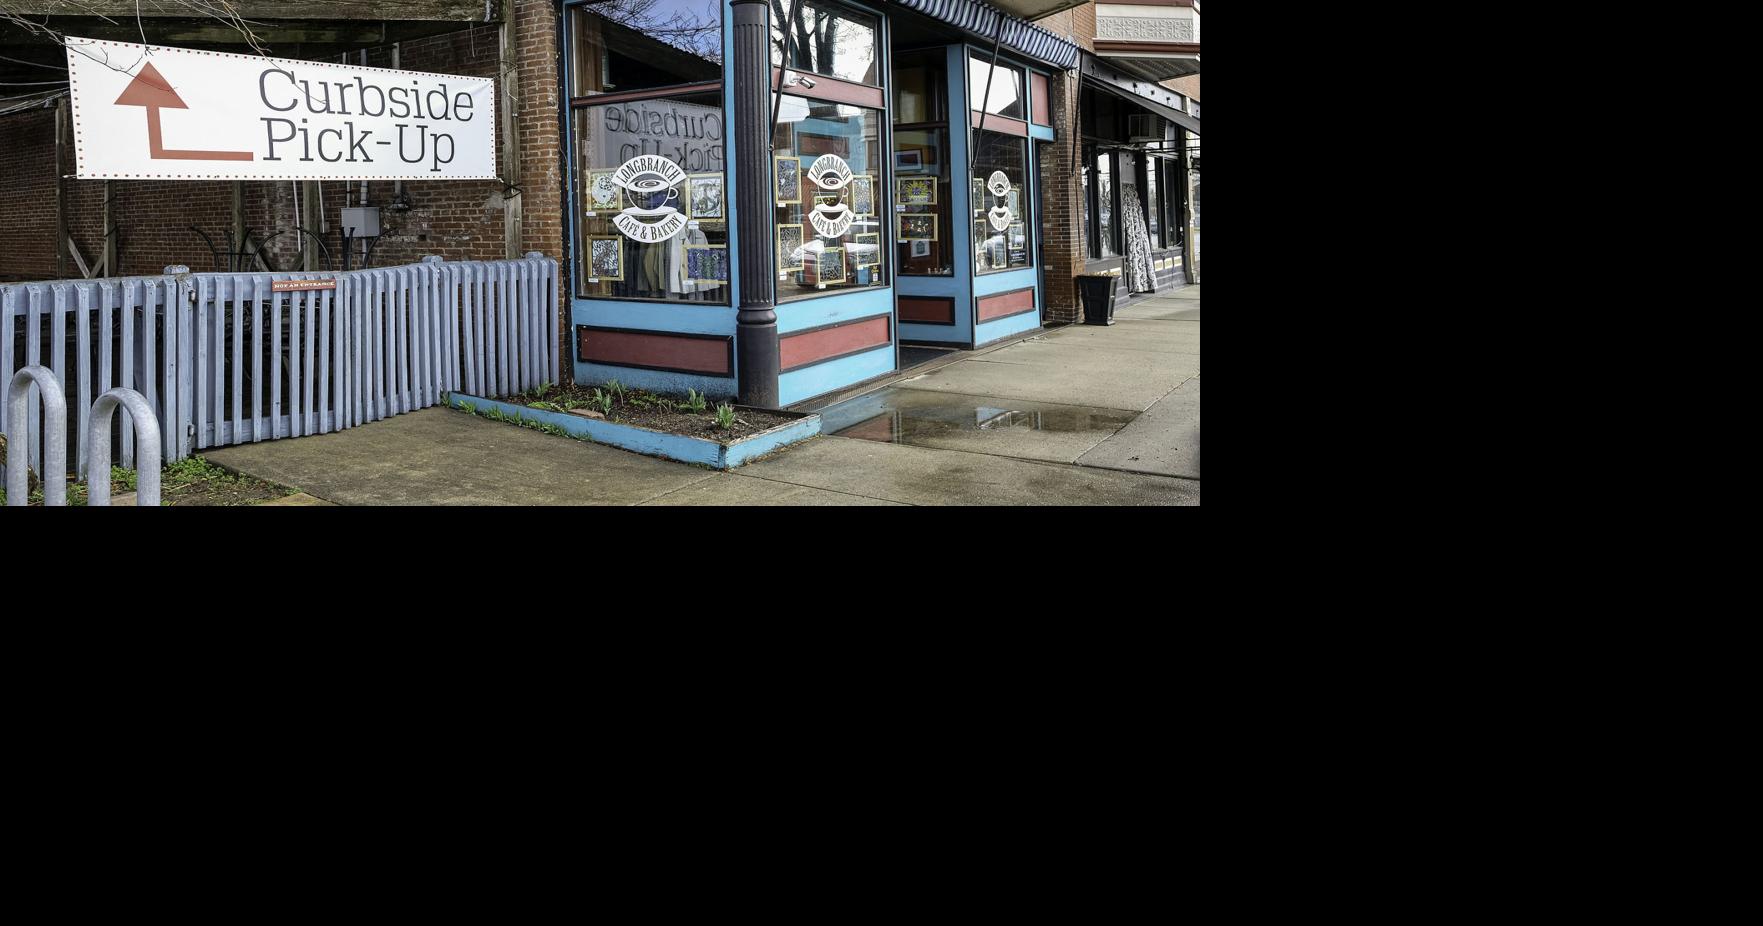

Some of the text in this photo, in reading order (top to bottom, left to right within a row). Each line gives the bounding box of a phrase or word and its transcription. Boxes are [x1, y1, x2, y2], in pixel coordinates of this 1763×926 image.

[259, 68, 474, 122] Curbside
[260, 116, 455, 172] Pick-Up
[616, 157, 681, 184] LONGBRANCH
[640, 225, 648, 239] &
[651, 215, 682, 240] BAKERY
